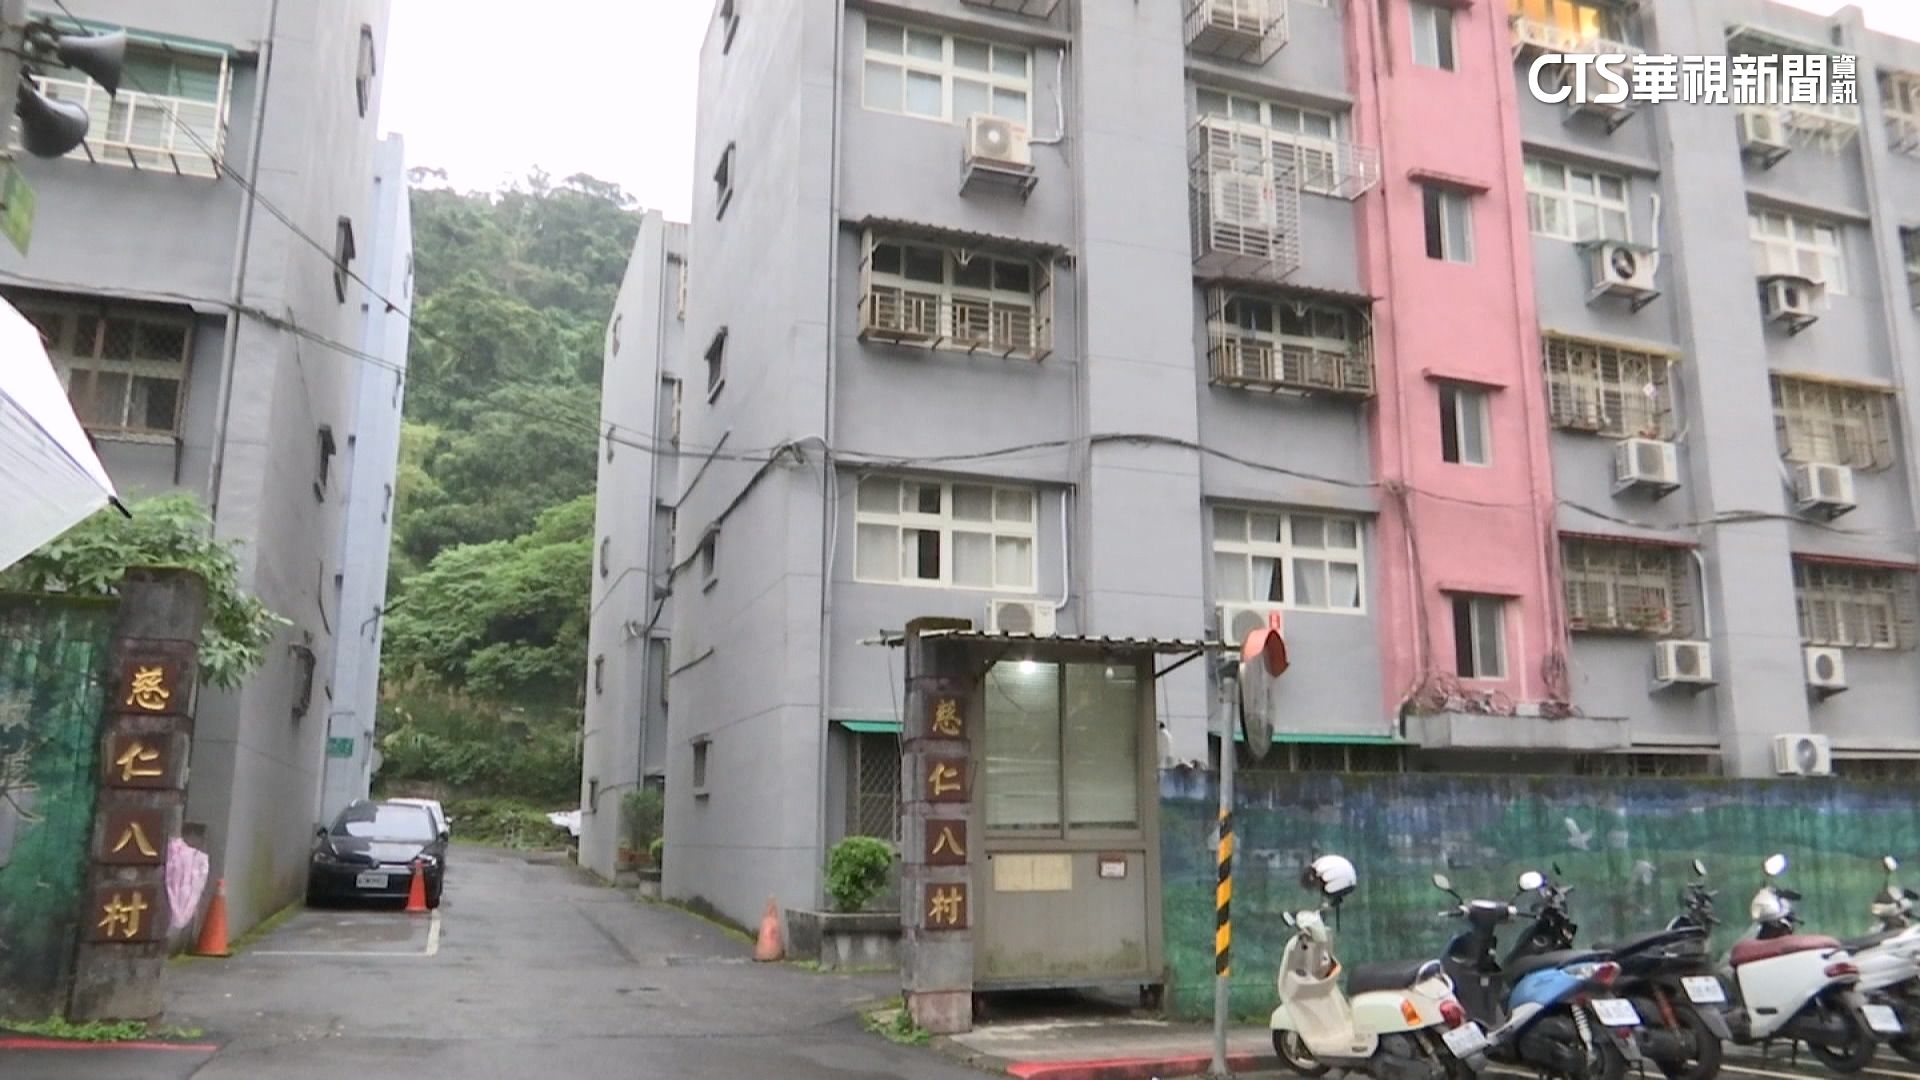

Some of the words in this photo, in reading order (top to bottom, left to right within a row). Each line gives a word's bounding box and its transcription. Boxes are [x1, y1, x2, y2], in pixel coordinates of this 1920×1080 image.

[97, 666, 170, 939] 慈仁八村
[928, 698, 966, 926] 慈仁八村
